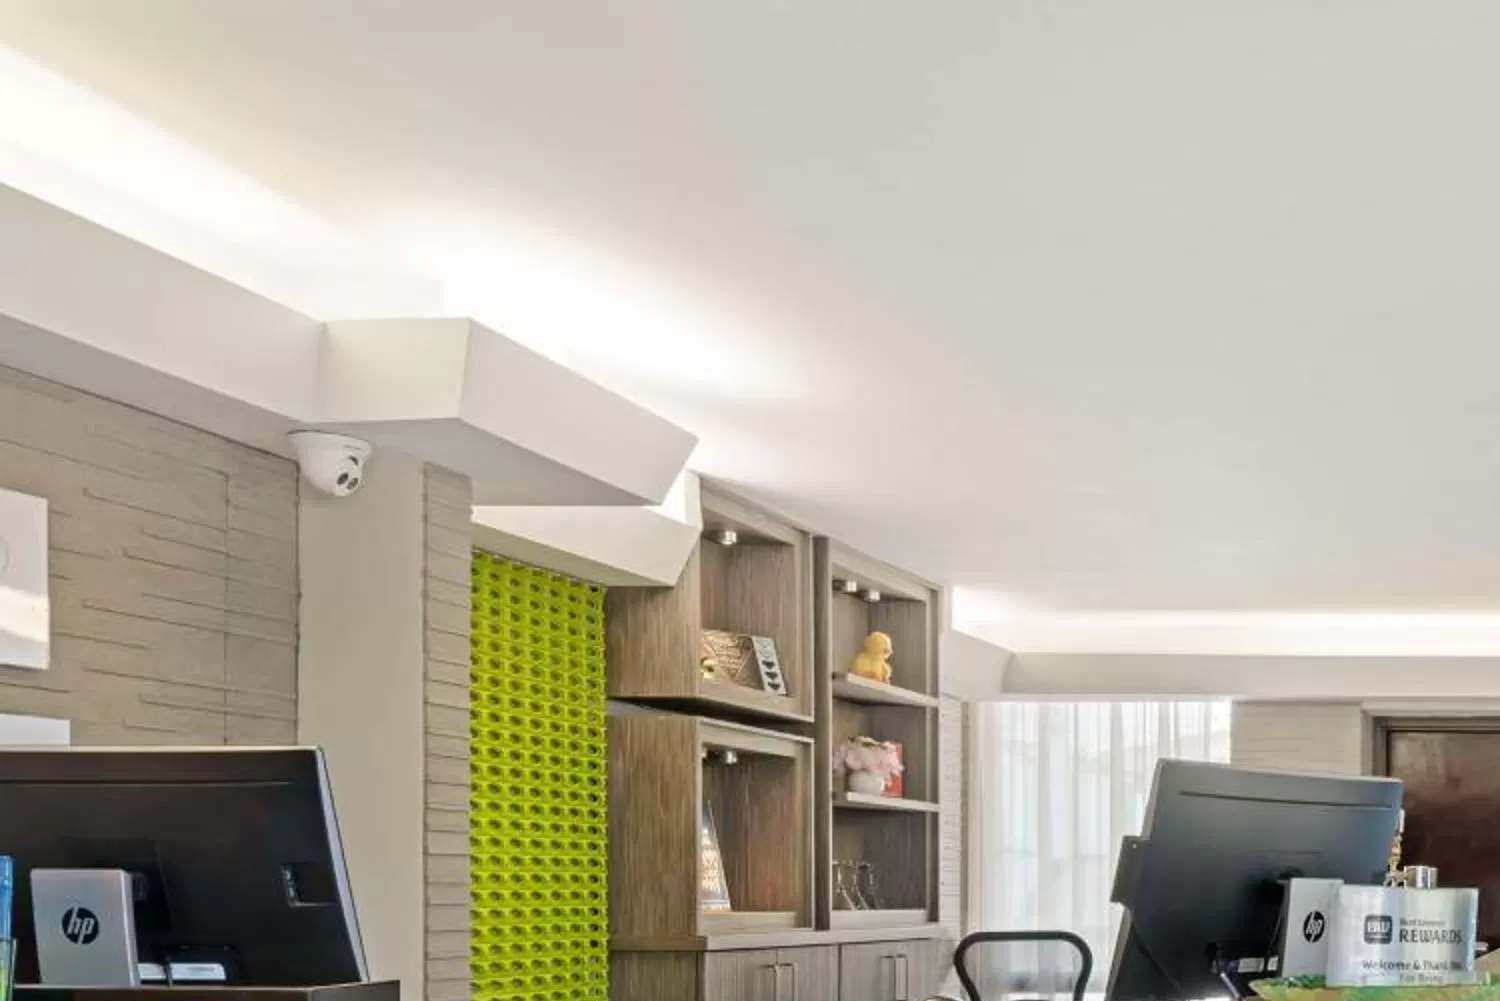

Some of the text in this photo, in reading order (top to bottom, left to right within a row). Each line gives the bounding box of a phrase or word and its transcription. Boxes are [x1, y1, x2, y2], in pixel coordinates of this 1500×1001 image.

[63, 906, 97, 945] hp
[1304, 910, 1325, 943] hp
[1399, 929, 1463, 943] REWARDS
[1362, 960, 1411, 971] Welcome
